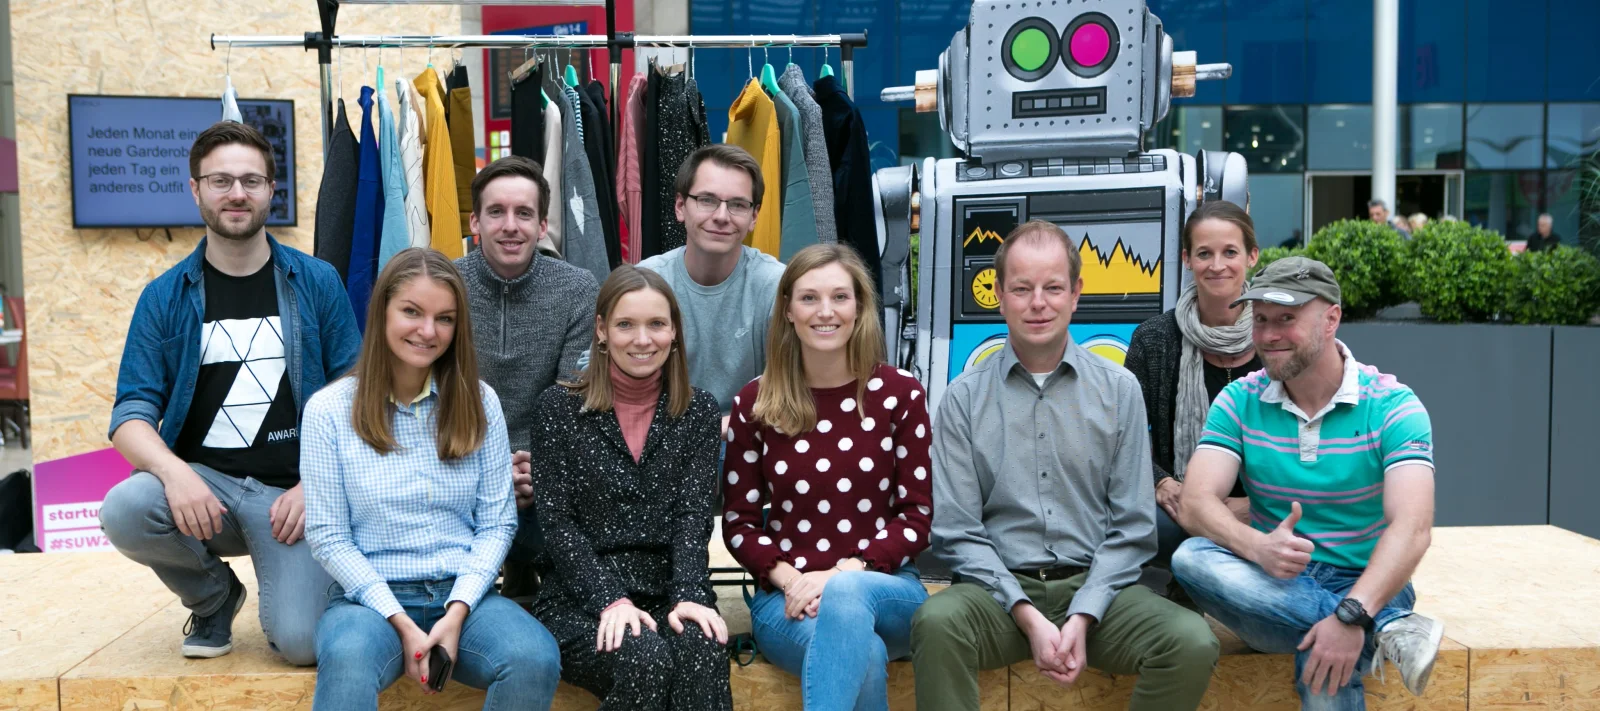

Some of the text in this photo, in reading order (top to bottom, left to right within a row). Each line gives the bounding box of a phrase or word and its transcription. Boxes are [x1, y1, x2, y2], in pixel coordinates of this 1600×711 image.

[87, 126, 200, 140] Jeden Monat ein
[87, 145, 190, 158] neue Garderob
[87, 163, 180, 178] jeden Tag ein
[89, 181, 184, 193] anderes Outfit
[49, 508, 99, 521] startu
[50, 535, 110, 550] #SUW2
